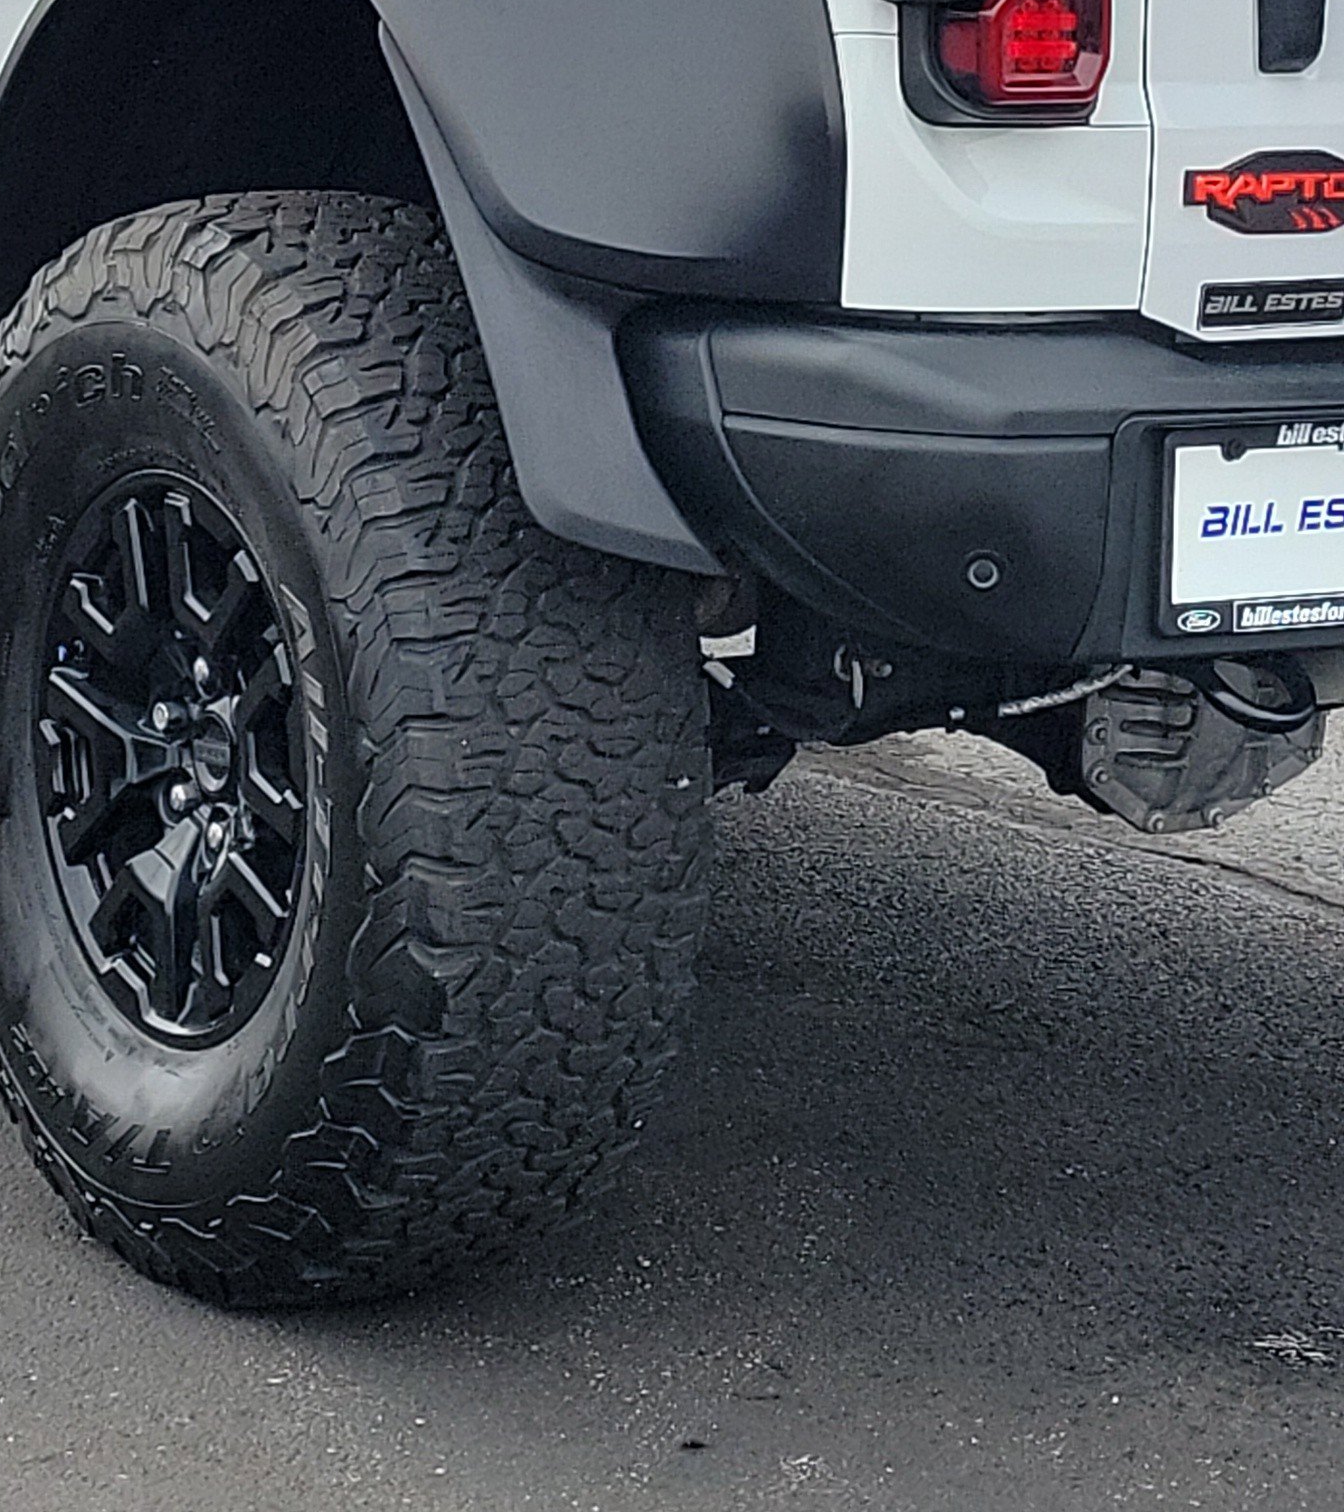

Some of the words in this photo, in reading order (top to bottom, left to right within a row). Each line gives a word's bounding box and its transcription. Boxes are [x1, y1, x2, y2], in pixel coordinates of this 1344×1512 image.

[1205, 294, 1258, 314] BILL
[1264, 291, 1344, 311] ESTES
[1276, 423, 1313, 446] bill
[1201, 501, 1284, 538] BILL
